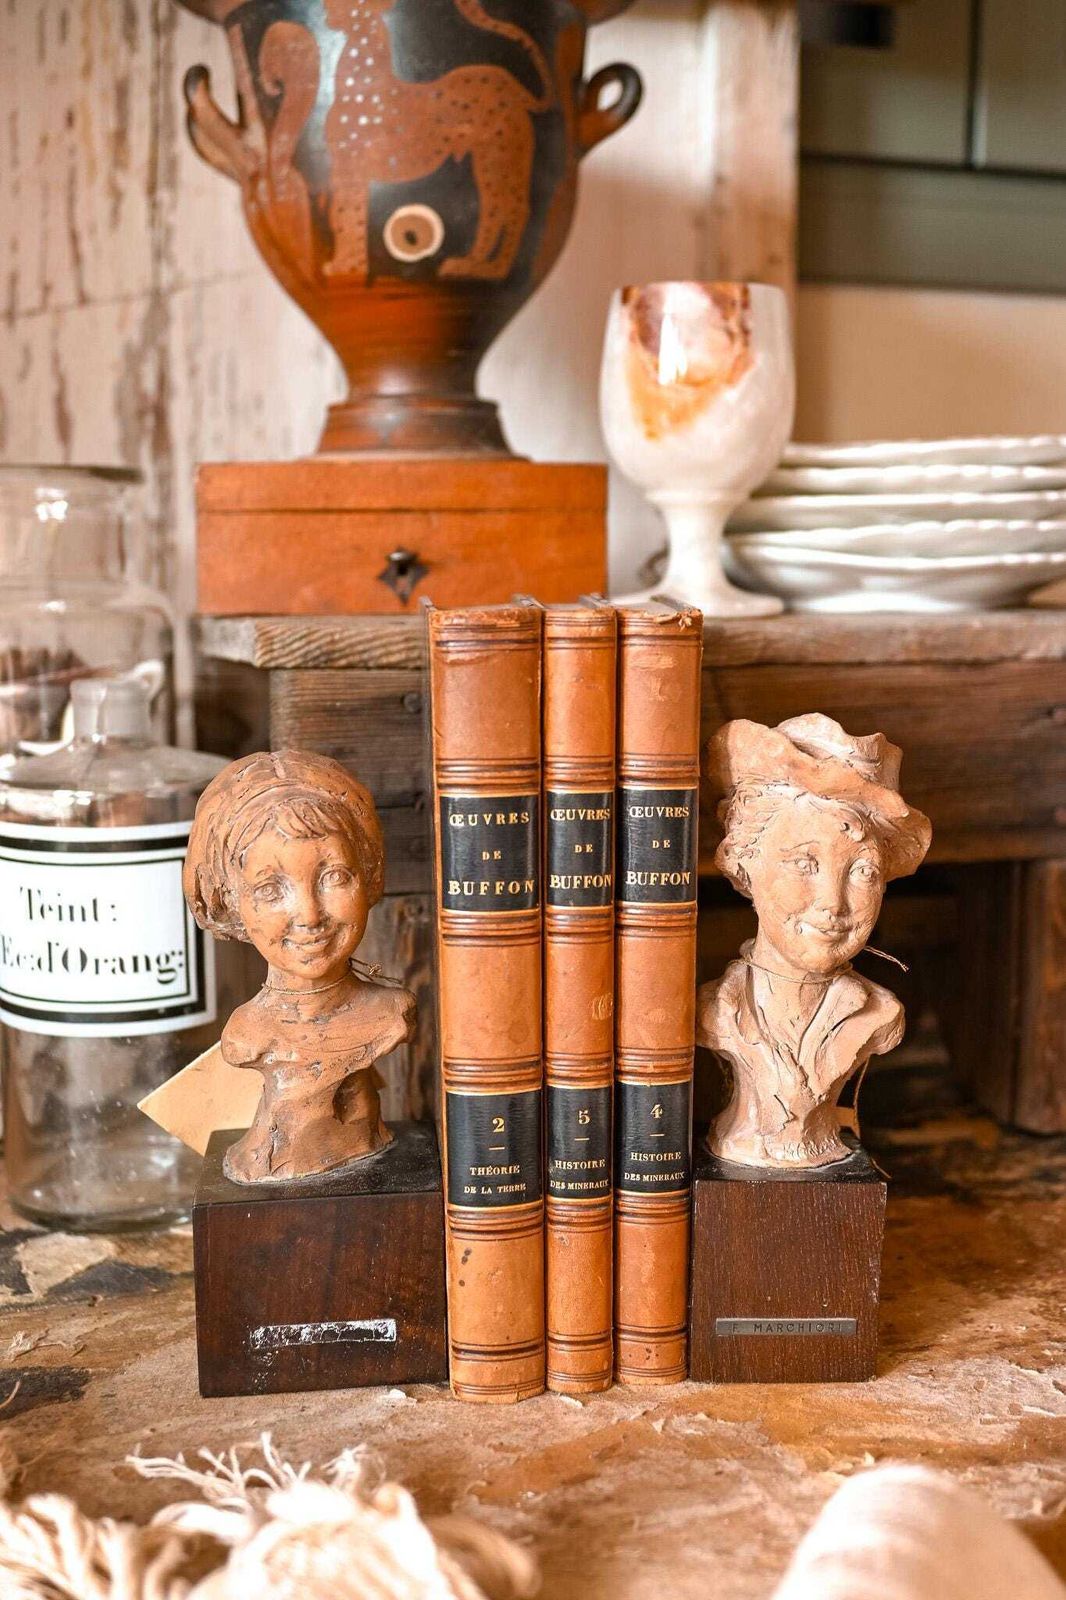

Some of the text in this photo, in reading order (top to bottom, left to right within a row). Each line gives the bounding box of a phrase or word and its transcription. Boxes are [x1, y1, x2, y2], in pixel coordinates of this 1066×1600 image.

[575, 843, 593, 854] DE
[652, 838, 671, 849] DE
[482, 850, 501, 861] DE
[550, 873, 612, 889] BUFFON
[626, 871, 691, 886] BUFFON
[448, 879, 535, 896] BUFFON
[650, 1104, 663, 1119] 4
[578, 1110, 591, 1125] 5
[492, 1117, 505, 1133] 2
[630, 1151, 682, 1162] HISTOIRE
[555, 1159, 606, 1170] HISTOIRE
[624, 1173, 640, 1181] DES
[464, 1184, 527, 1194] DE LA TERRE
[550, 1180, 566, 1189] DES
